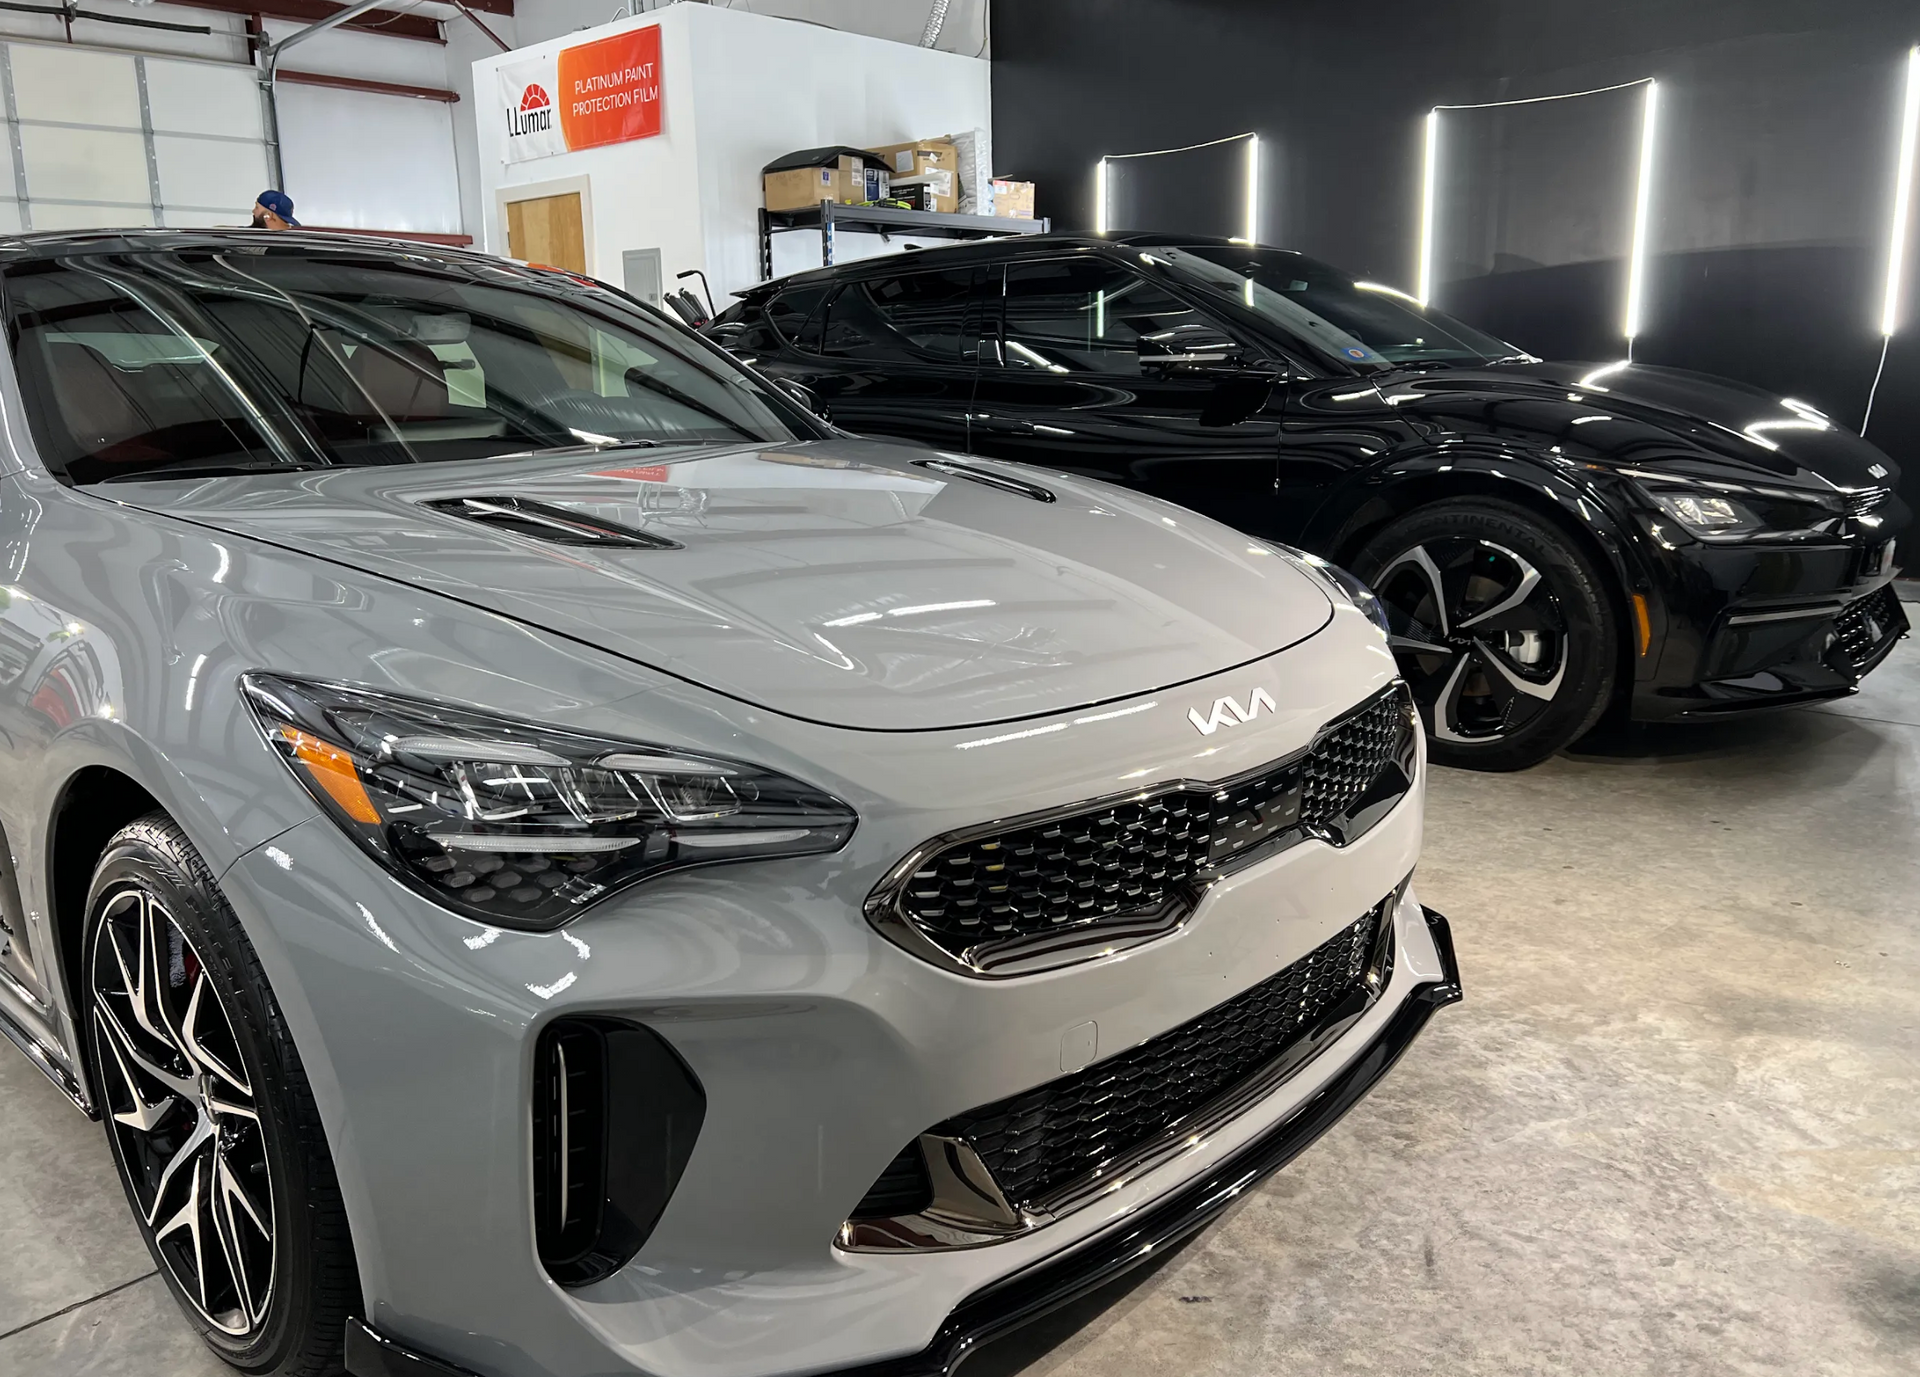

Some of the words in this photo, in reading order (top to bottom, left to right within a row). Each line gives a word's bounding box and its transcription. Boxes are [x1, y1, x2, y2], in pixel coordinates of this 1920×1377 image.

[575, 73, 623, 95] PLATINUM
[625, 63, 653, 86] PAINT
[573, 90, 631, 117] PROTECTION
[634, 85, 658, 103] FILM
[1186, 687, 1277, 736] KIA
